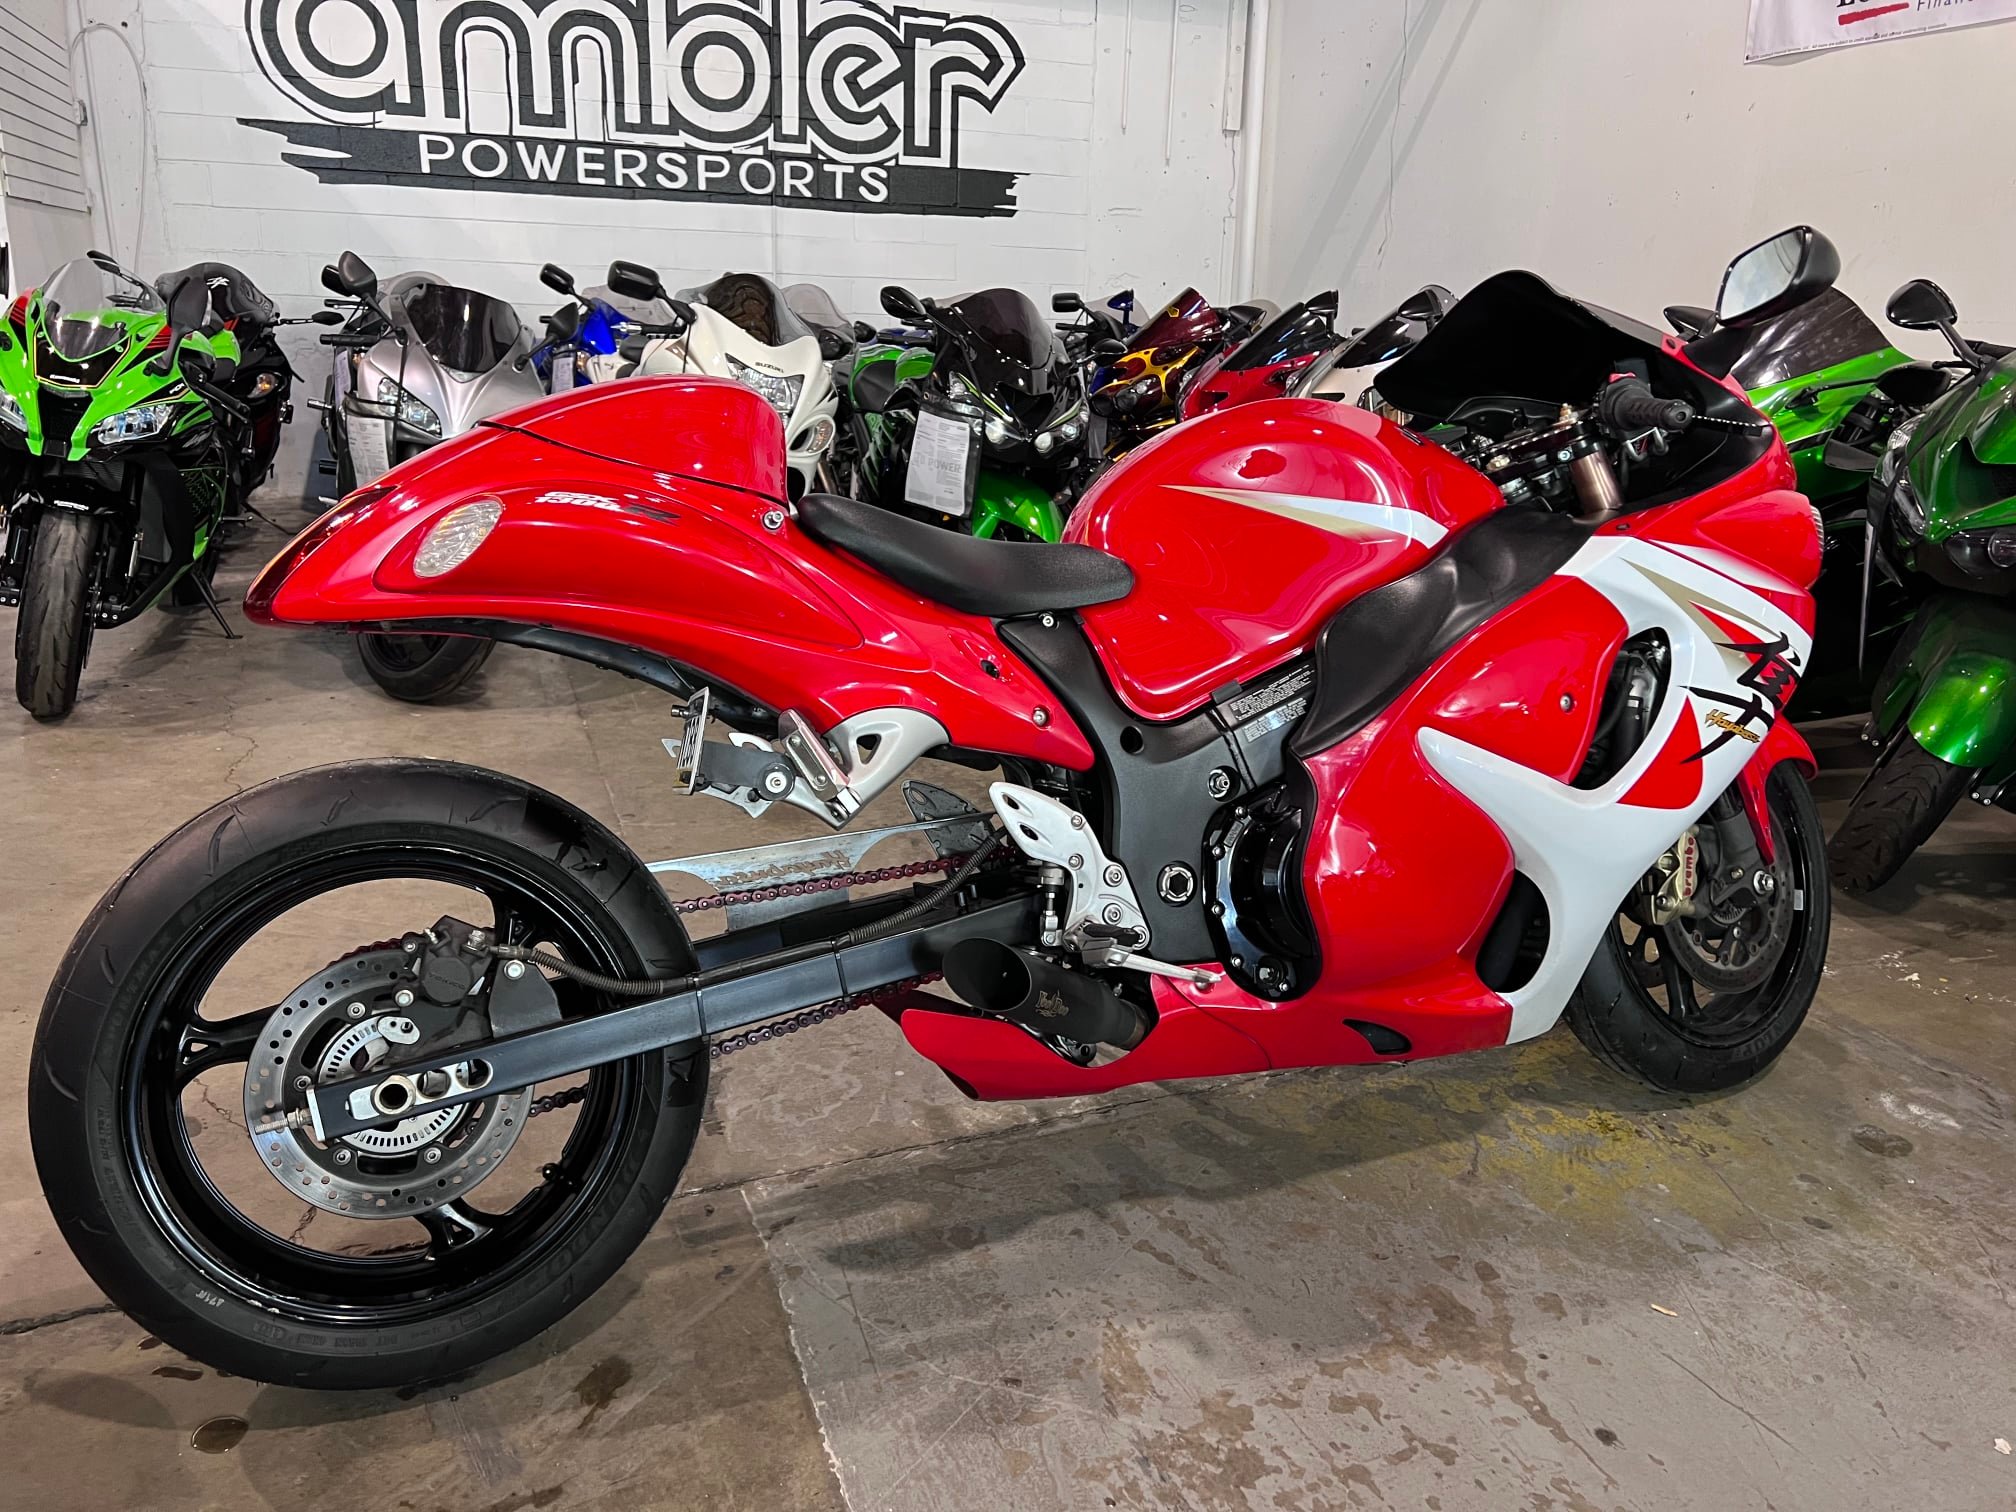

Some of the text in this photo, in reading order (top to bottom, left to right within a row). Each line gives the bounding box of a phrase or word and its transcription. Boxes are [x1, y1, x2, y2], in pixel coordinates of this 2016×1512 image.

[246, 0, 1025, 167] ambler
[418, 133, 889, 203] POWERSPORTS
[1682, 836, 1695, 897] brembo
